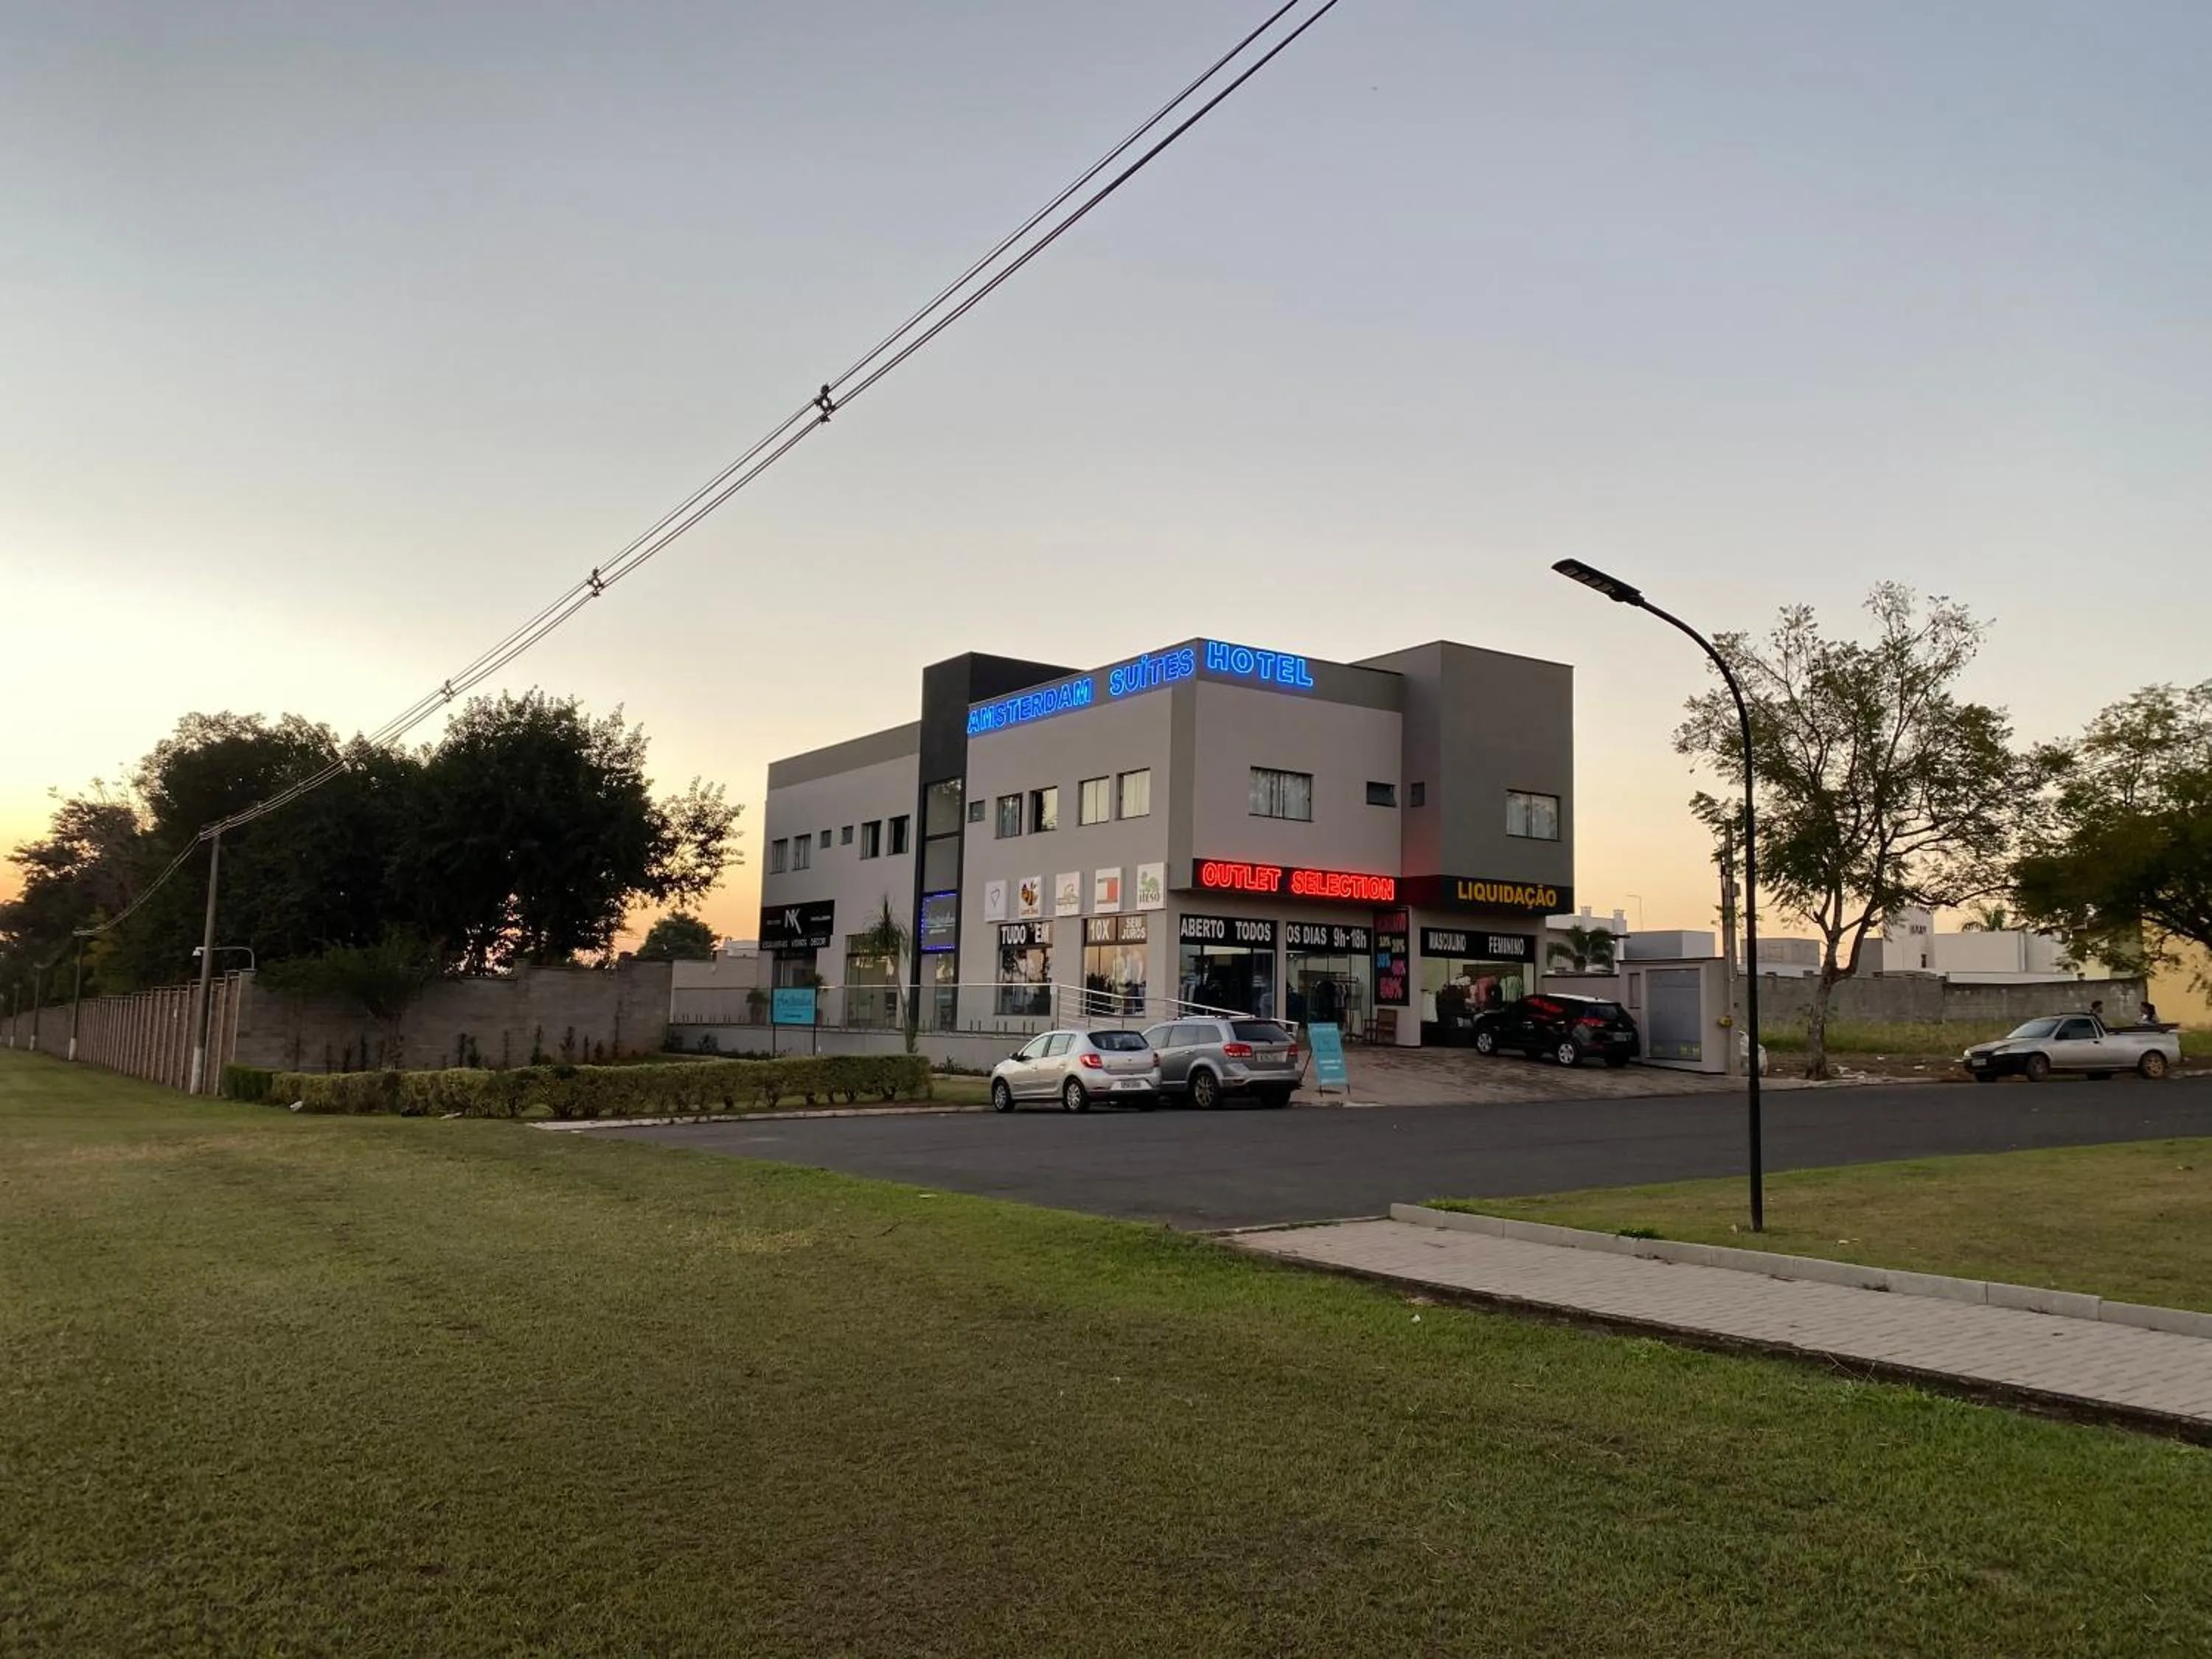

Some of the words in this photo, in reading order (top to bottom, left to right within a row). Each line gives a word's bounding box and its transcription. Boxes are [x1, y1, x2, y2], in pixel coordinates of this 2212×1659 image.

[1207, 641, 1313, 688] HOTEL
[967, 678, 1092, 734] AMSTERDAM
[1110, 649, 1194, 695] SUÍTES
[1203, 863, 1281, 891] OUTLET
[1292, 871, 1394, 900] SELECTION
[1458, 881, 1557, 908] LIQUIDAÇÃO
[1001, 925, 1026, 945] TUDO
[1034, 922, 1049, 943] EM
[1121, 928, 1146, 940] JUROS
[1180, 917, 1225, 939] ABERTO
[1235, 921, 1271, 942] TODOS
[1287, 925, 1301, 943] OS
[1303, 926, 1327, 945] DIAS
[1489, 936, 1525, 956] FEMININO
